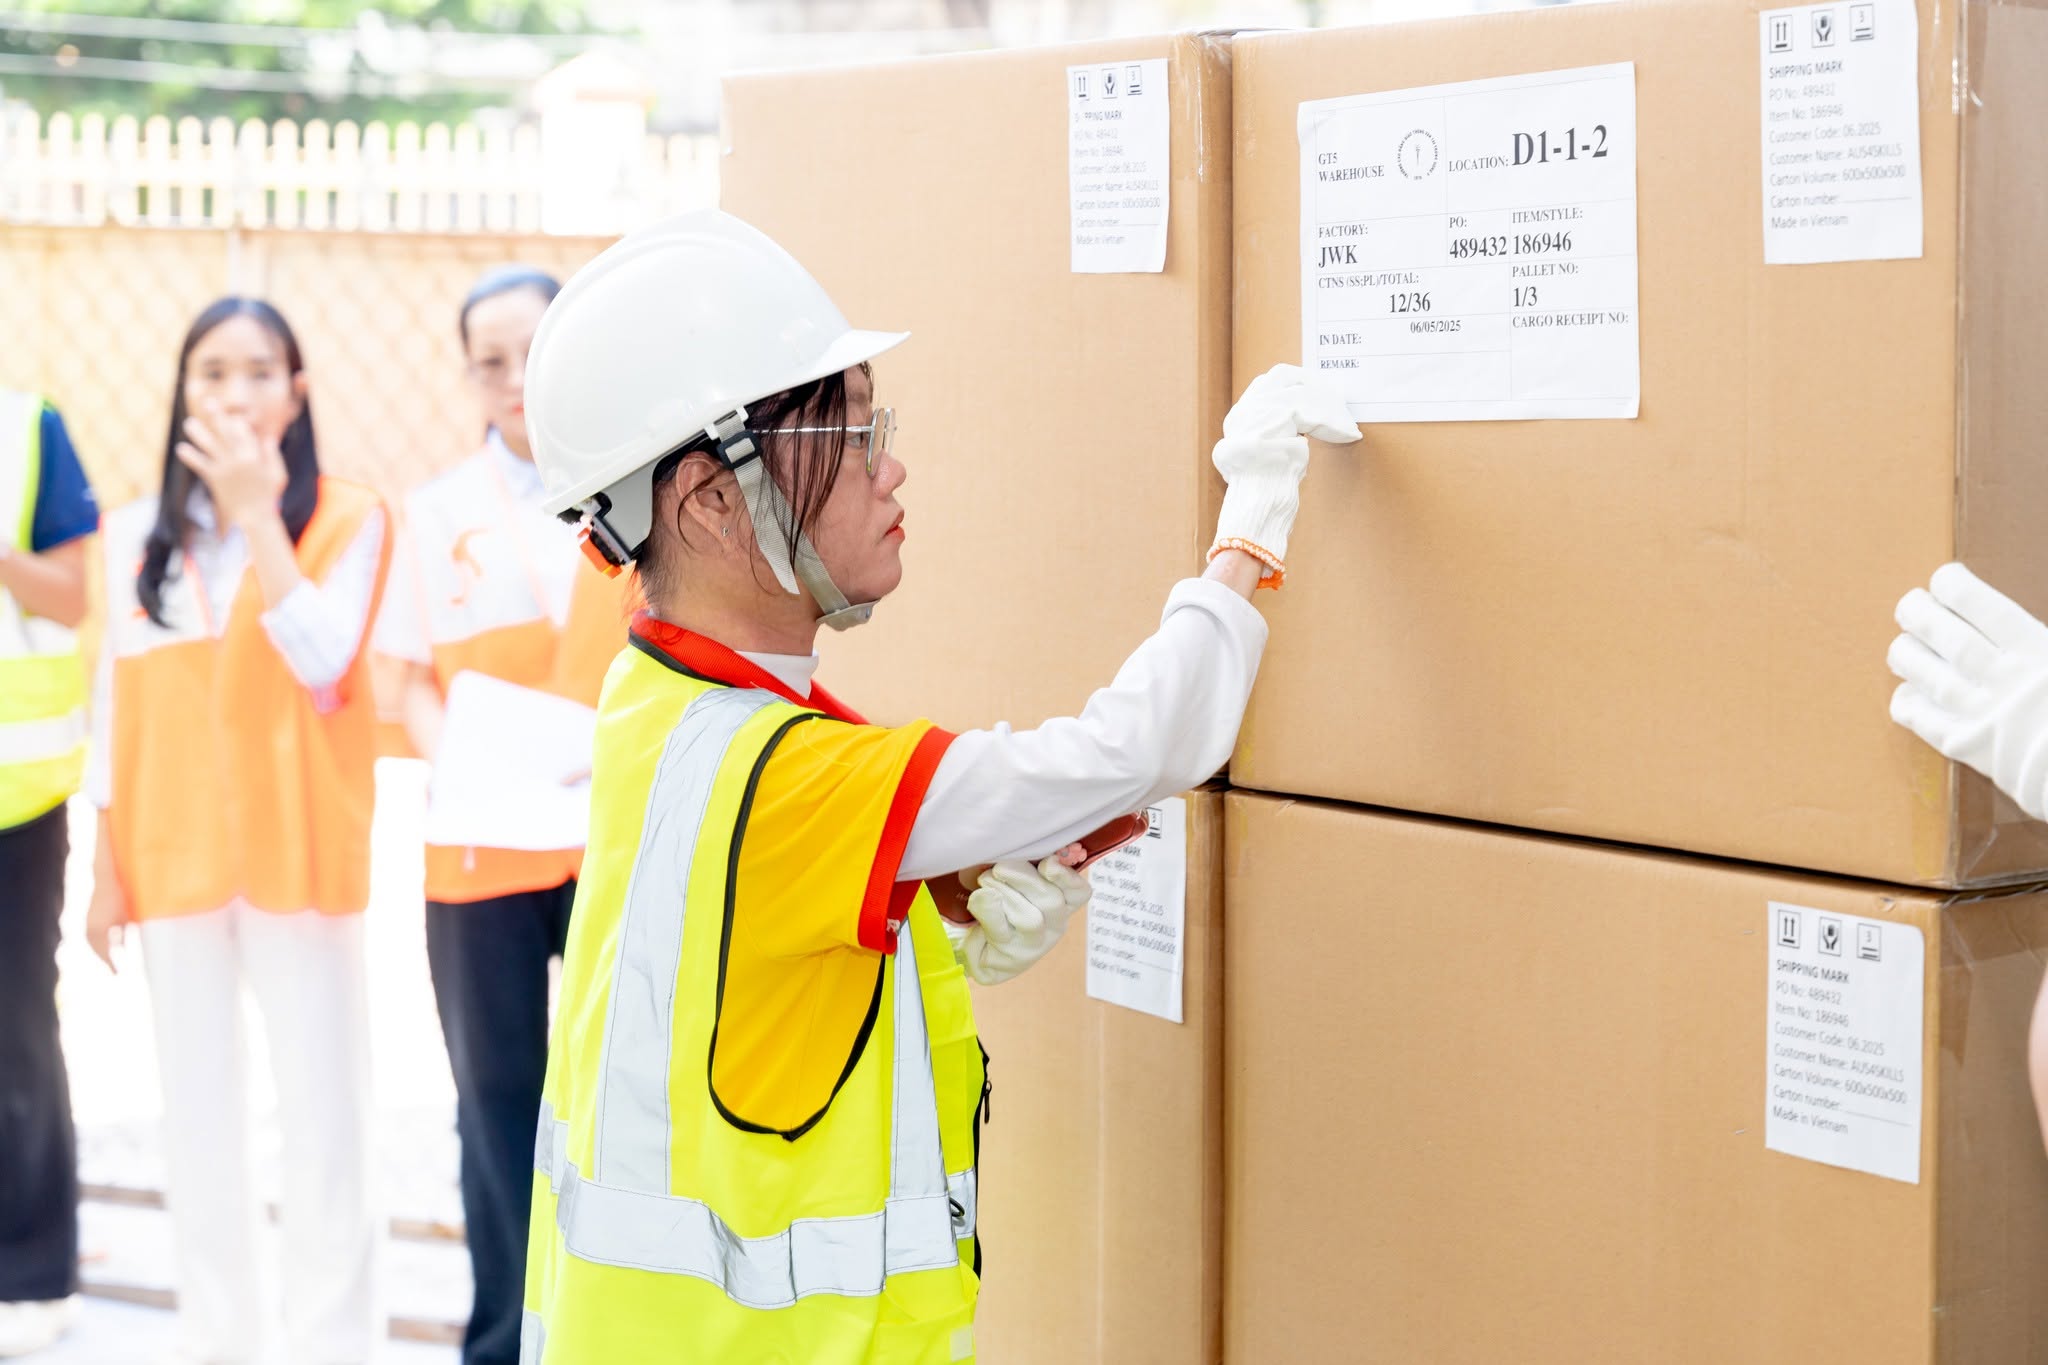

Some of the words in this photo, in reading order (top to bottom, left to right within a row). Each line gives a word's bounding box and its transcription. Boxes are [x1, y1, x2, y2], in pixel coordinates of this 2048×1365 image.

[1769, 62, 1812, 79] SHIPPING
[1815, 60, 1844, 75] MARK
[1769, 87, 1783, 101] PO
[1104, 109, 1124, 120] MARK
[1769, 109, 1790, 122] Item
[1769, 128, 1812, 144] Customer
[1814, 126, 1841, 140] Code:
[1842, 121, 1881, 138] 06.2025
[1512, 124, 1609, 167] D1-1-2
[1318, 152, 1338, 166] GT5
[1449, 156, 1509, 173] LOCATION:
[1769, 151, 1812, 166] Customer
[1815, 148, 1843, 162] Name:
[1318, 165, 1385, 183] WAREHOUSE
[1769, 173, 1801, 187] Carton
[1802, 170, 1839, 185] Volume:
[1842, 164, 1907, 182] 600x500x500
[1770, 194, 1801, 208] Carton
[1449, 216, 1468, 230] PO:
[1512, 207, 1583, 224] ITEM/STYLE:
[1771, 216, 1798, 229] Made
[1800, 215, 1808, 227] in
[1810, 213, 1849, 227] Vietnam
[1318, 224, 1368, 239] FACTORY:
[1449, 235, 1508, 260] 489432
[1512, 231, 1572, 256] 186946
[1318, 244, 1358, 269] JWK
[1512, 263, 1556, 278] PALLET
[1558, 262, 1579, 276] NO:
[1318, 275, 1345, 289] CTNS
[1389, 291, 1431, 314] 12/36
[1512, 285, 1538, 308] 1/3
[1410, 320, 1462, 335] 06/05/2025
[1512, 314, 1554, 329] CARGO
[1555, 312, 1605, 328] RECEIPT
[1607, 311, 1630, 325] NO:
[1319, 333, 1332, 346] IN
[1332, 332, 1362, 346] DATE:
[1320, 358, 1360, 370] REMARK:
[1776, 959, 1818, 979] SHIPPING
[1820, 967, 1850, 984] MARK
[1776, 980, 1789, 995] PO
[1808, 987, 1842, 1006] 489432
[1776, 1002, 1795, 1016] Item
[1815, 1009, 1849, 1028] 186946
[1775, 1021, 1816, 1041] Customer
[1818, 1030, 1844, 1047] Code:
[1847, 1036, 1885, 1057] 06.2025
[1774, 1042, 1816, 1063] Customer
[1818, 1052, 1849, 1070] Name:
[1774, 1063, 1803, 1081] Carton
[1805, 1071, 1841, 1089] Volume:
[1844, 1079, 1908, 1104] 600x500x500
[1773, 1084, 1803, 1102] Carton
[1772, 1105, 1798, 1122] Made
[1800, 1112, 1809, 1125] in
[1810, 1114, 1849, 1134] Vietnam
